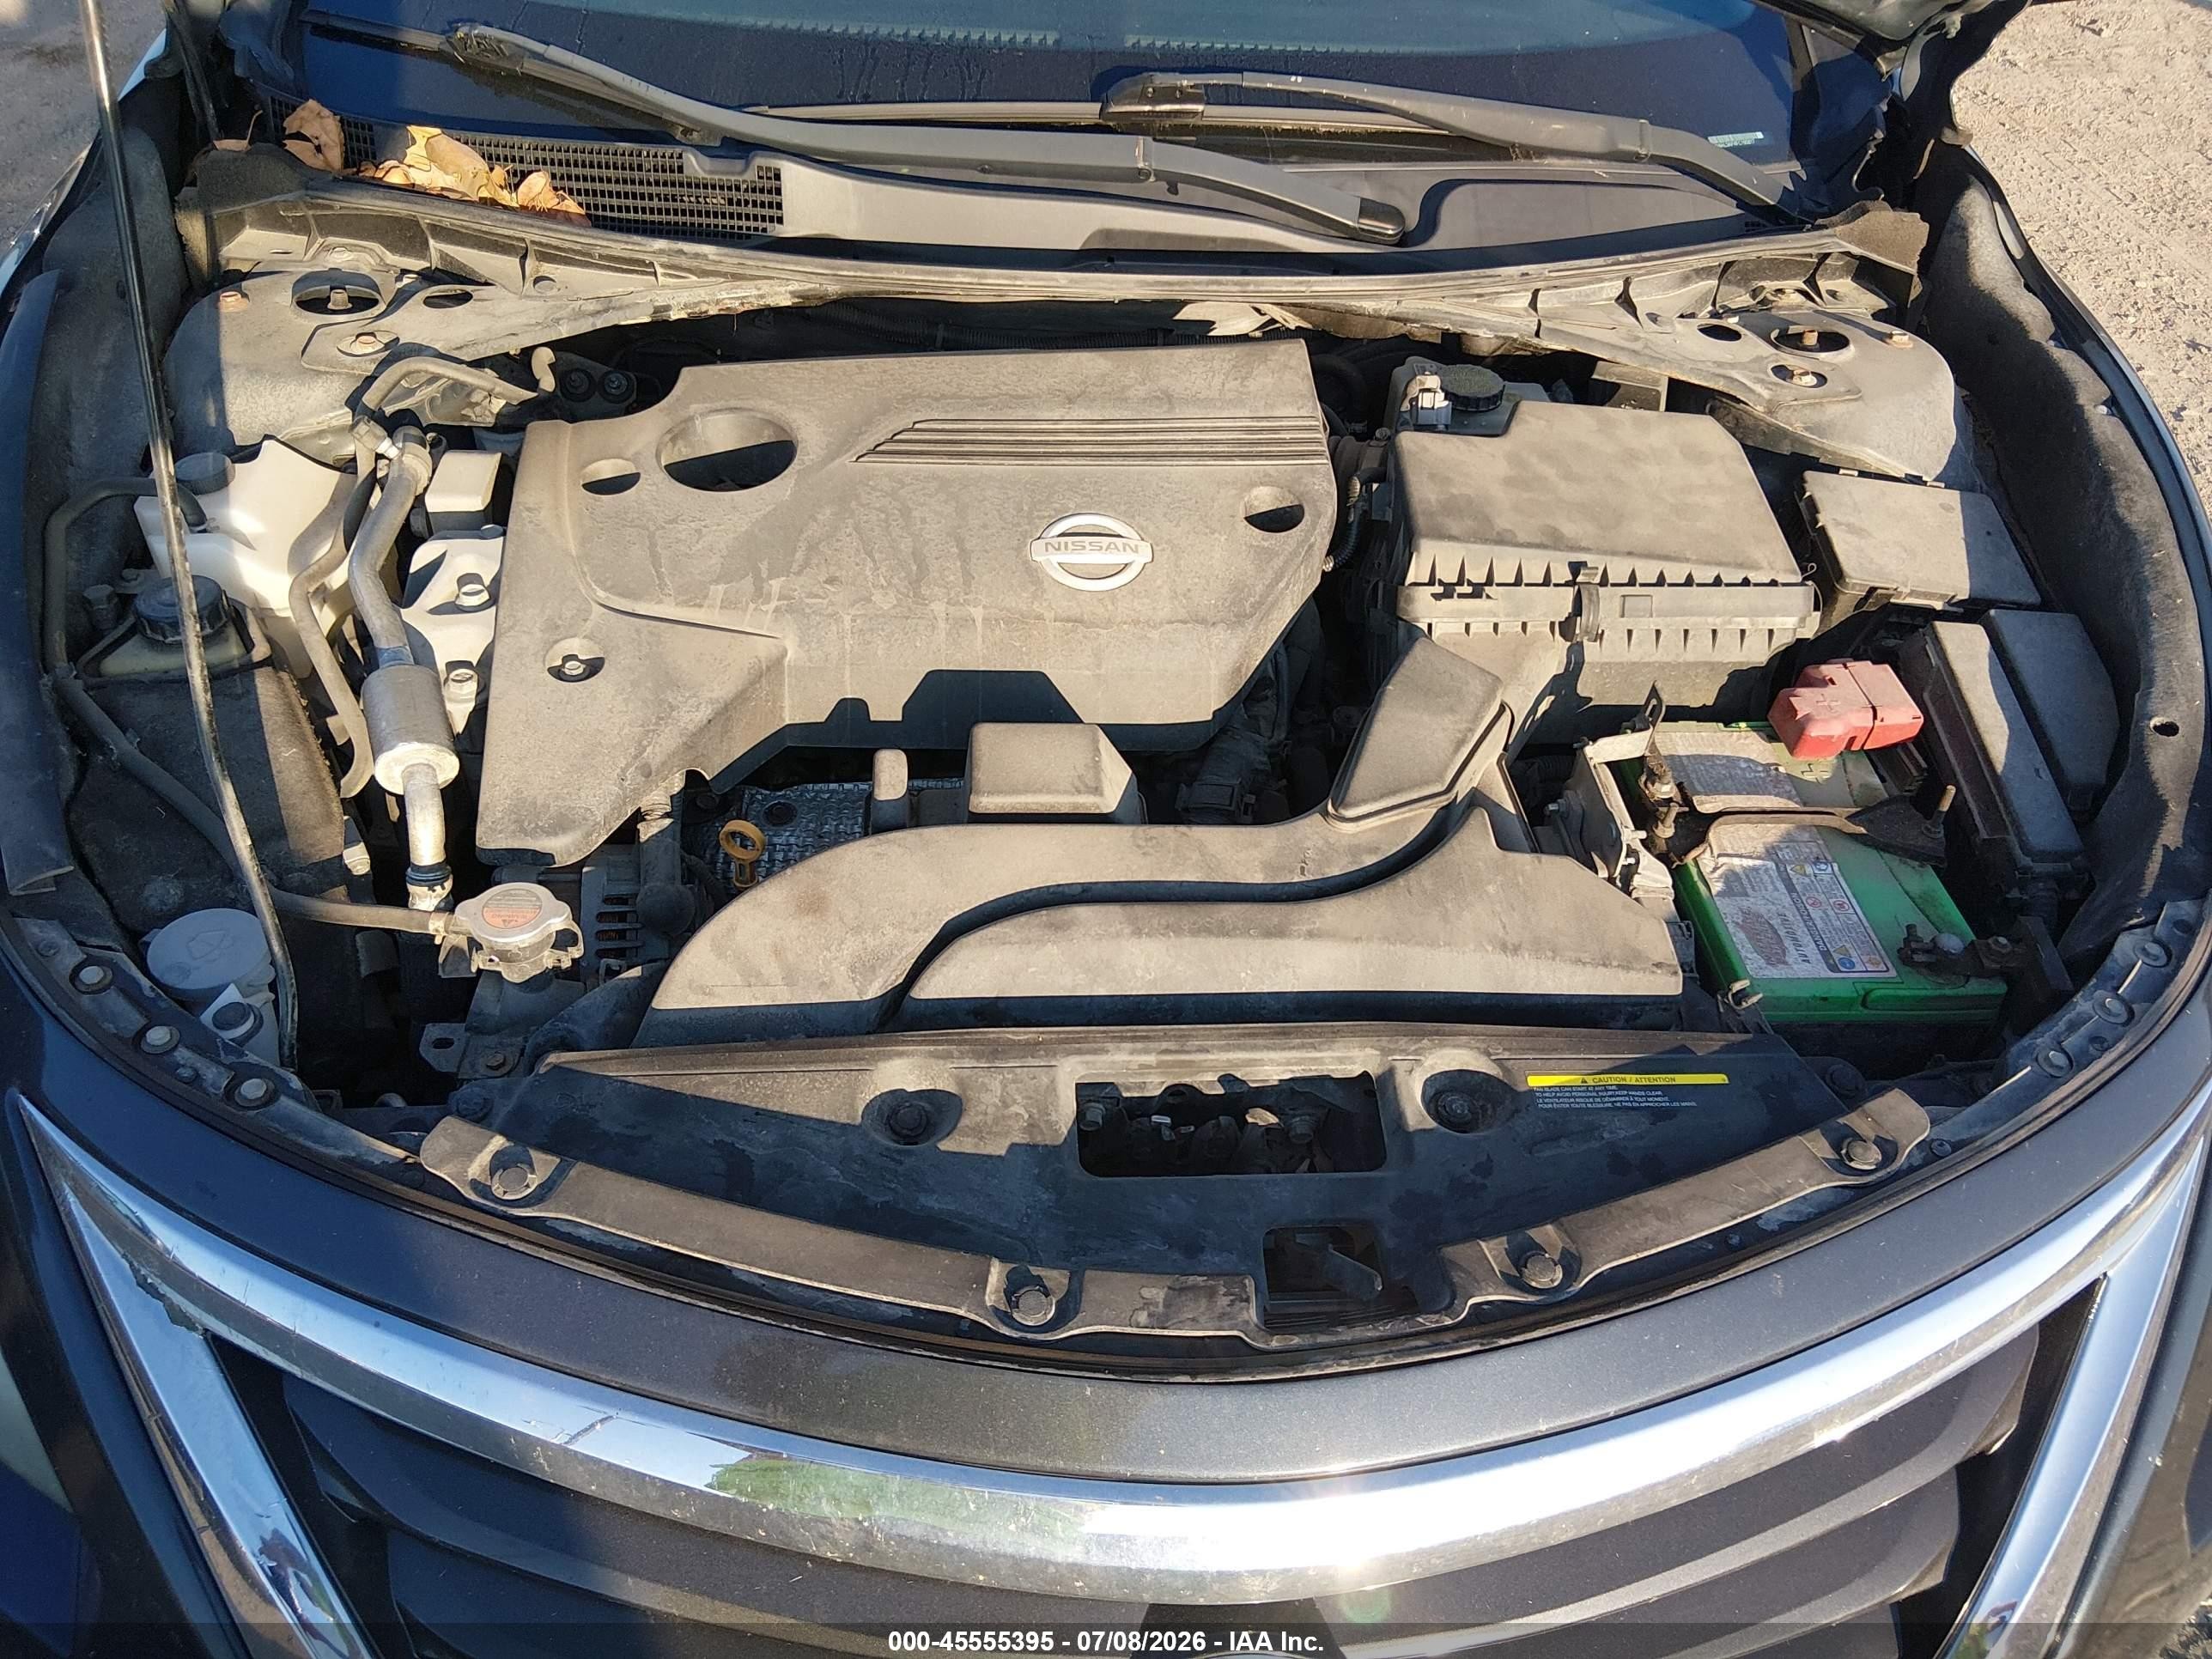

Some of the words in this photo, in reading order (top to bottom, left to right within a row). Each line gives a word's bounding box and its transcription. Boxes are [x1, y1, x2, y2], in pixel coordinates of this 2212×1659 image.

[1045, 541, 1139, 554] NISSAN
[1777, 911, 1811, 964] AUTOMOTIVE
[1790, 891, 1827, 951] DANGER/POISON
[1634, 1076, 1676, 1085] ATTENTION
